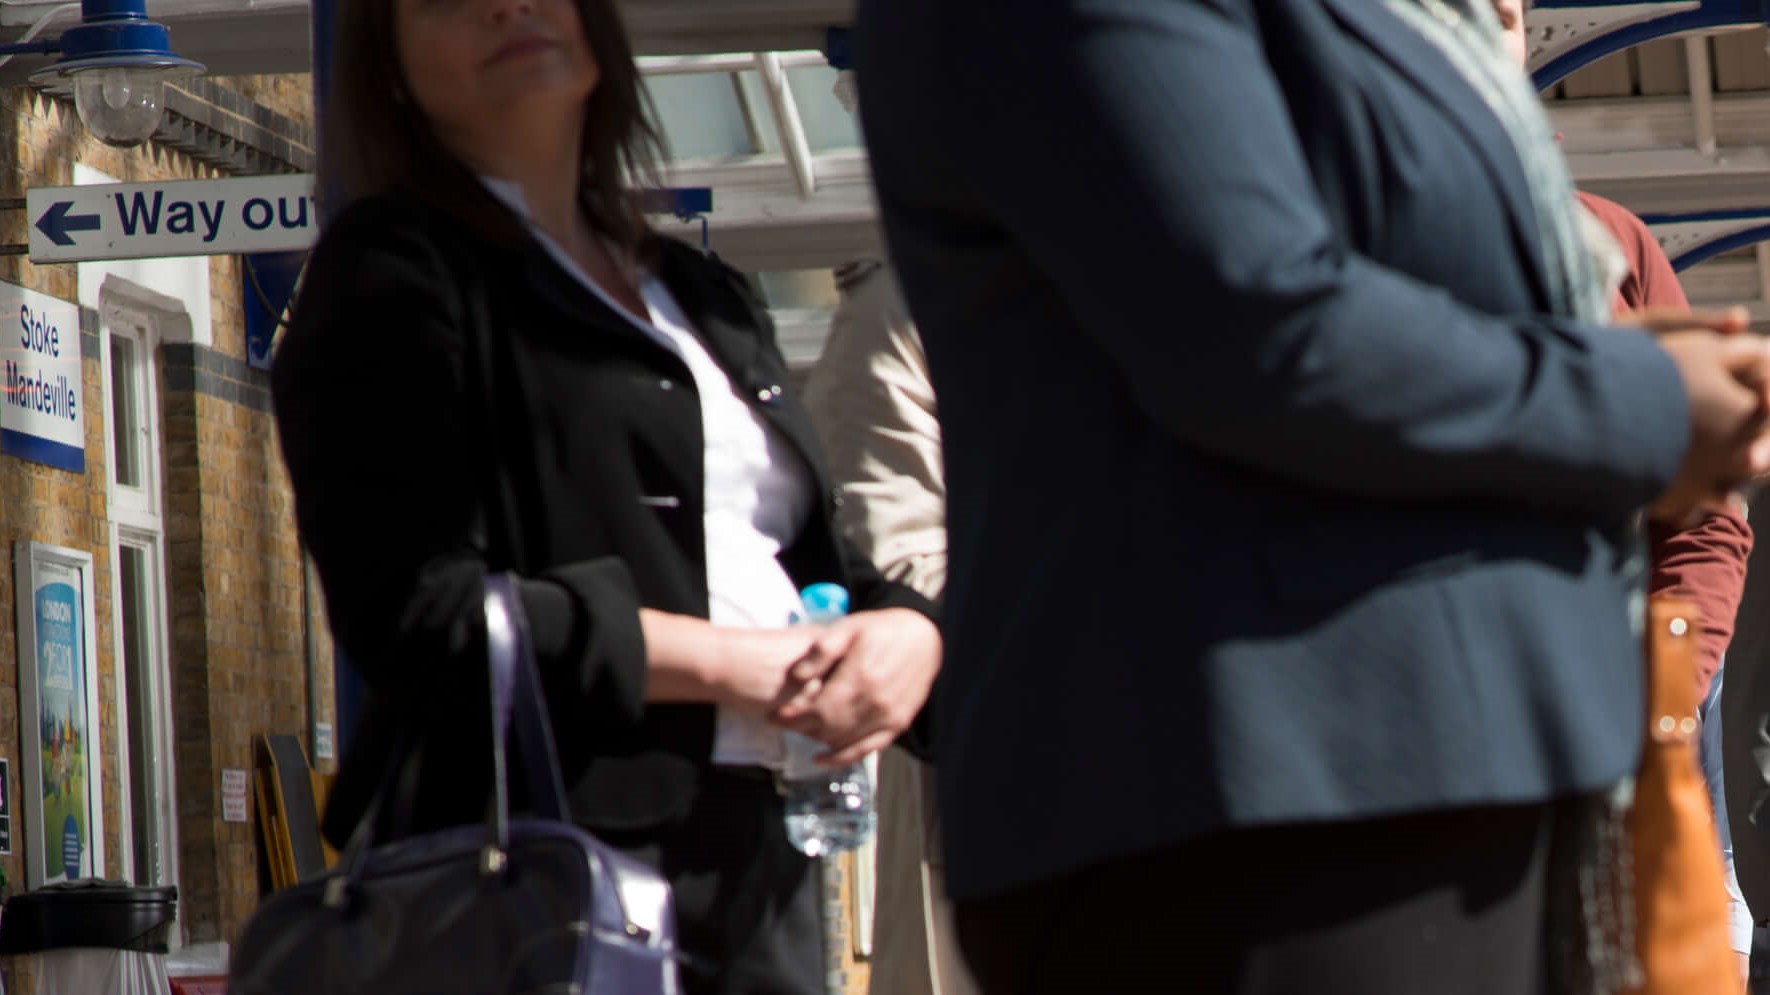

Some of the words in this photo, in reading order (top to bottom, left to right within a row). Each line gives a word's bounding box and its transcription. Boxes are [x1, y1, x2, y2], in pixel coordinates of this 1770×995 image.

[114, 190, 225, 242] Way
[242, 196, 315, 231] ou
[20, 303, 59, 358] Stoke
[6, 359, 76, 422] Mandeville
[42, 599, 72, 624] LONDON
